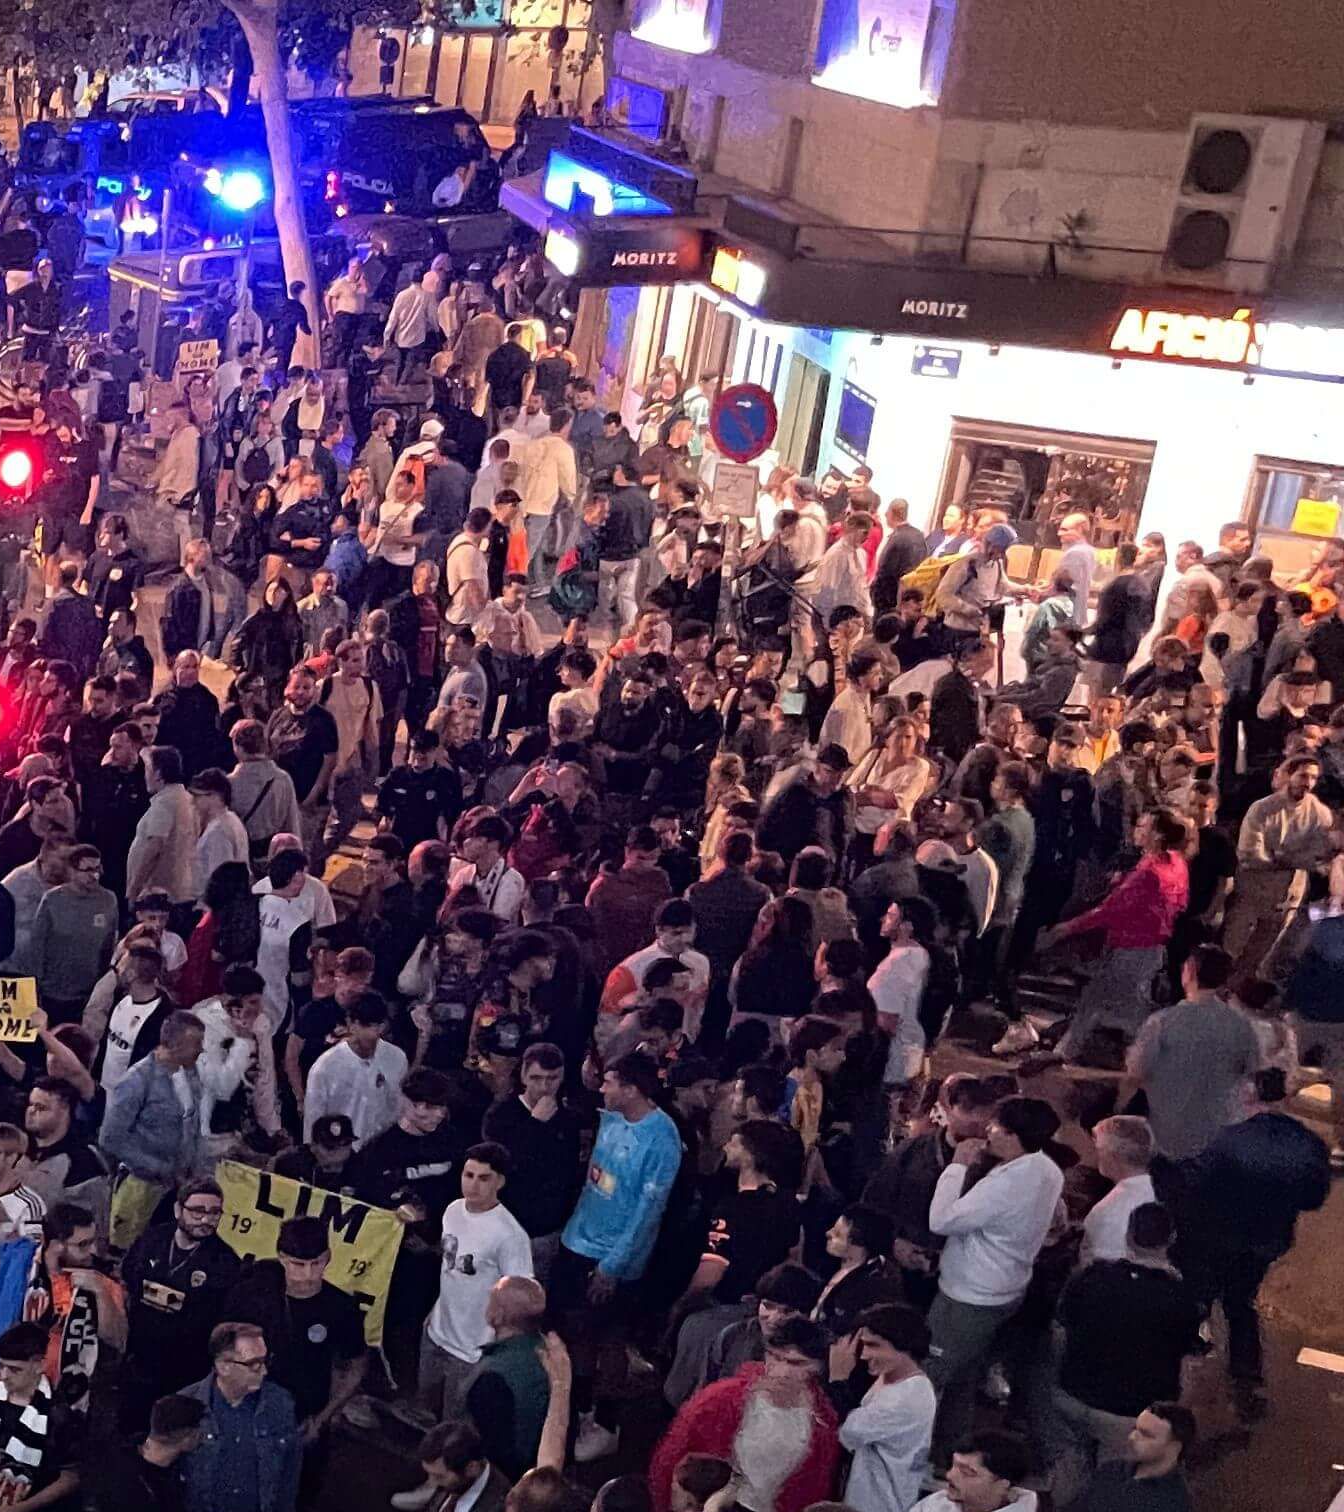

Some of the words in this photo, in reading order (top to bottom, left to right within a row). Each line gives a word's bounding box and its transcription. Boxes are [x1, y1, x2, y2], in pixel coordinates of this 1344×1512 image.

[612, 251, 678, 266] MORITZ
[901, 299, 968, 318] MORITZ
[255, 1172, 372, 1244] LIM
